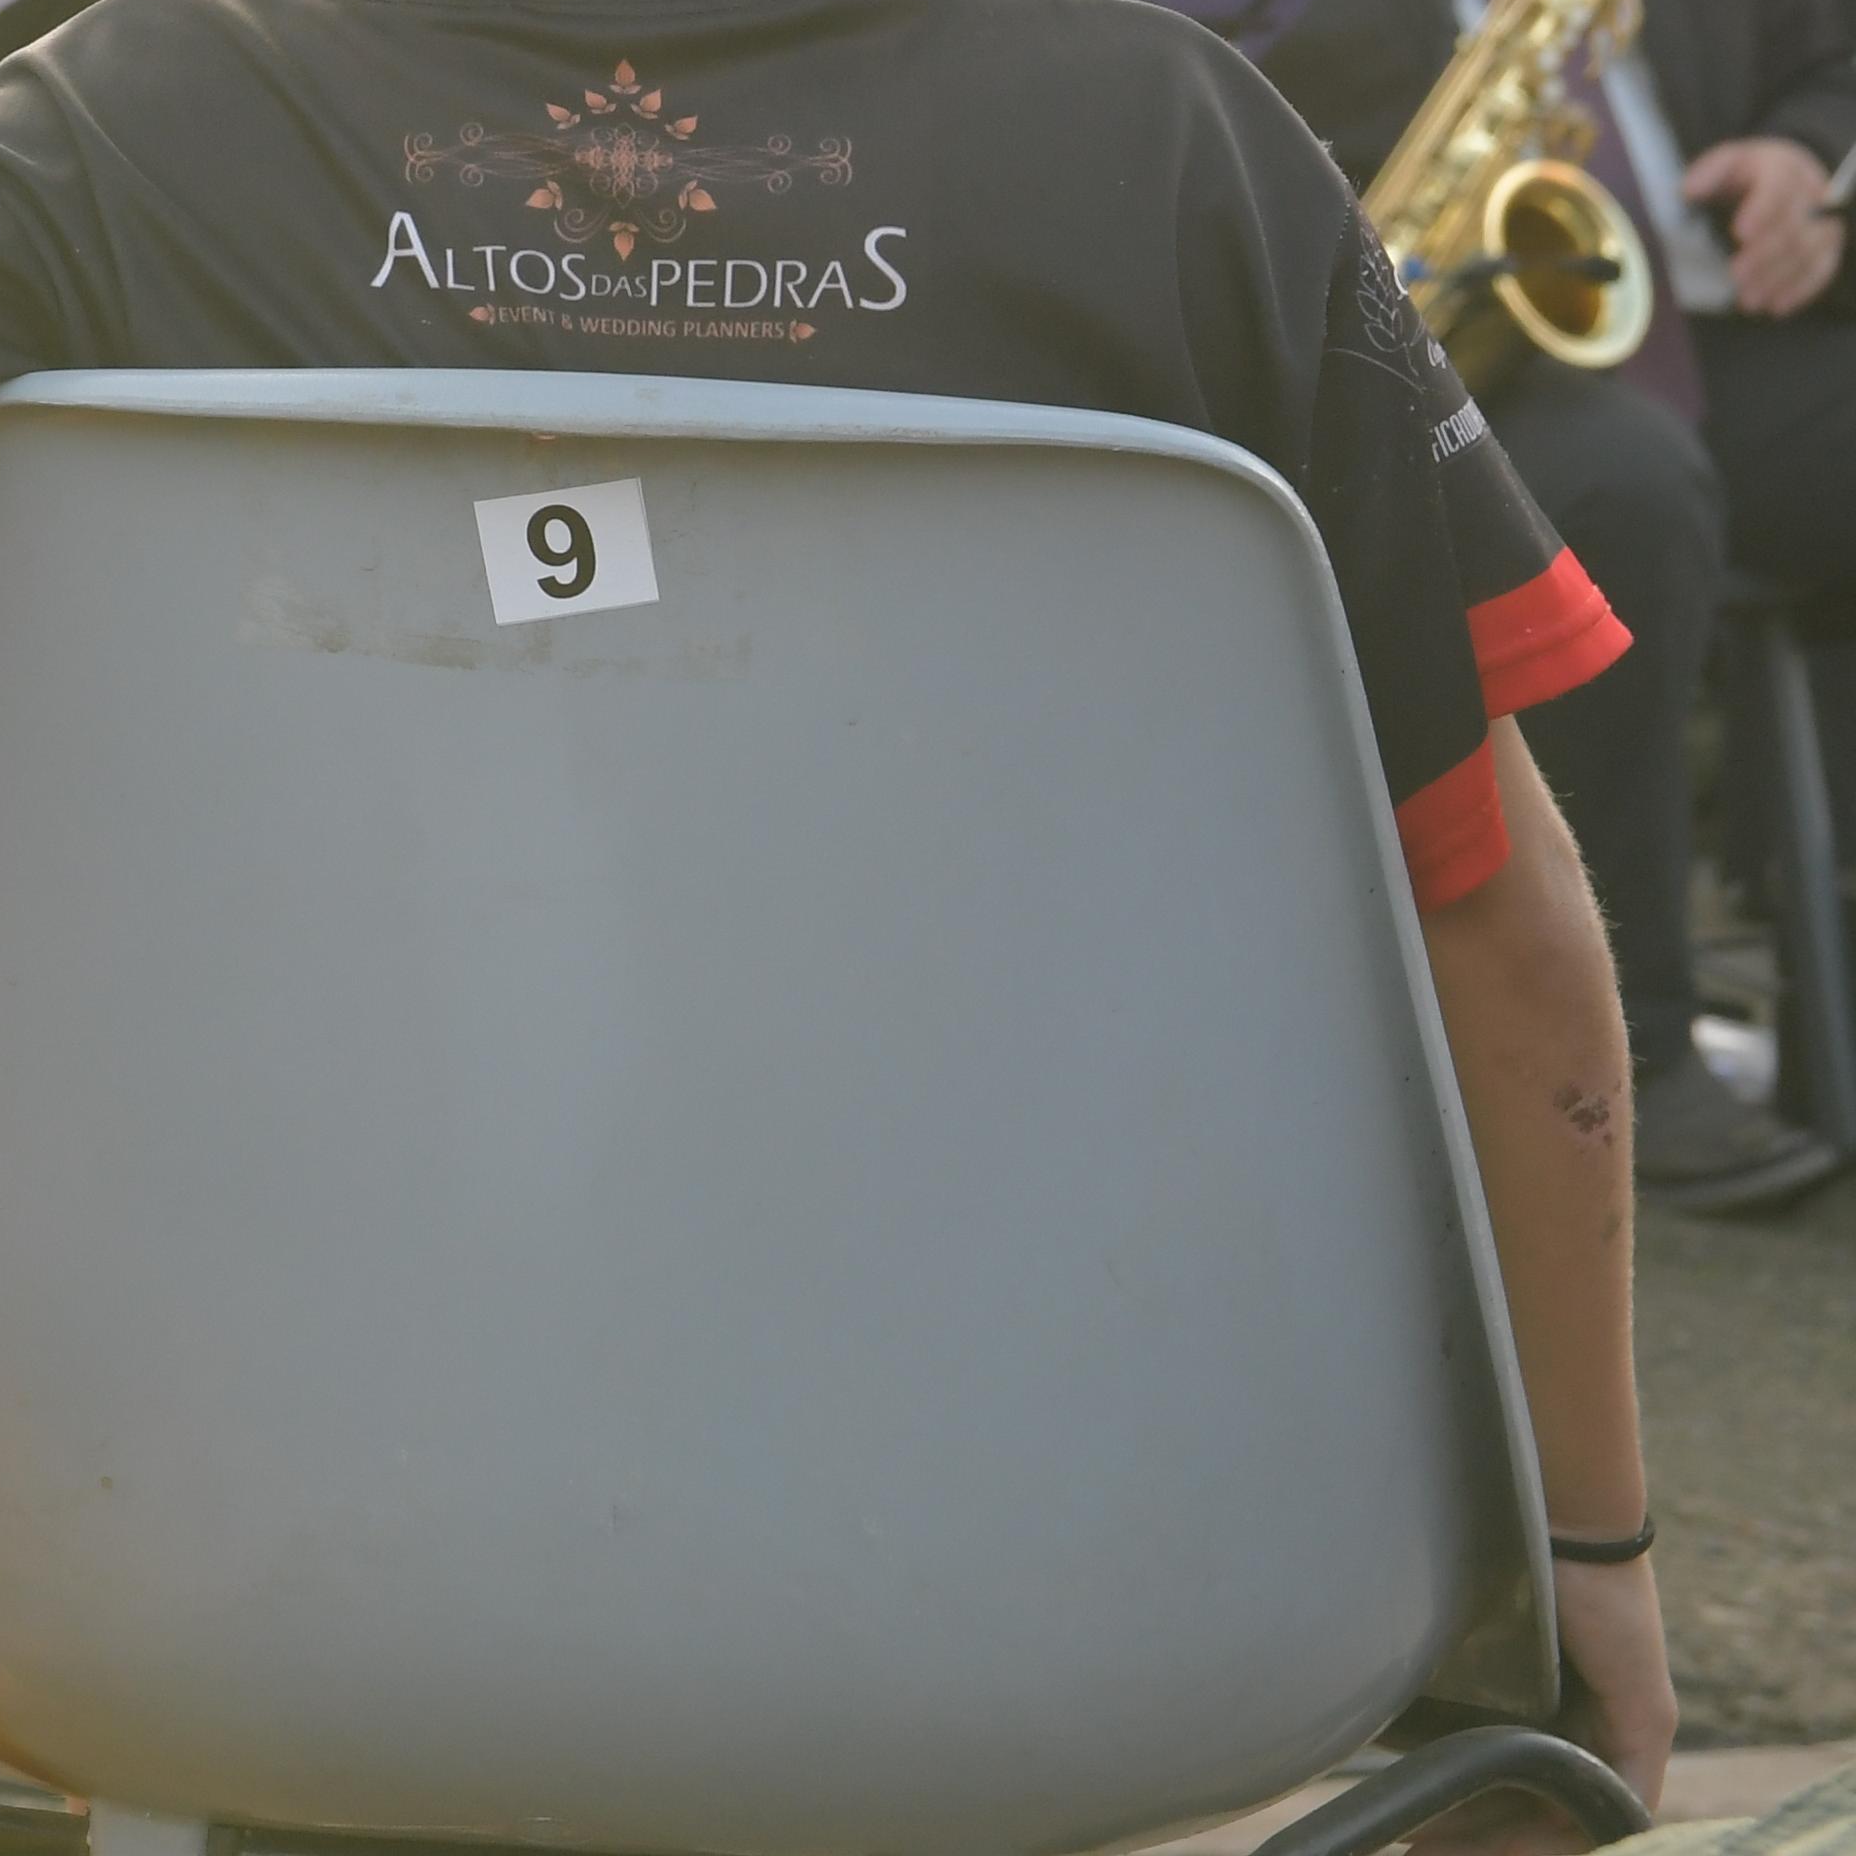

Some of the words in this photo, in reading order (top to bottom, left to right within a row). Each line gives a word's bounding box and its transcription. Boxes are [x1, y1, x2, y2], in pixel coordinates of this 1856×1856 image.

[498, 305, 555, 325] EVENT
[560, 313, 573, 330] &
[580, 315, 676, 337] WEDDING
[683, 320, 785, 339] PLANNERS
[526, 504, 596, 599] 9
